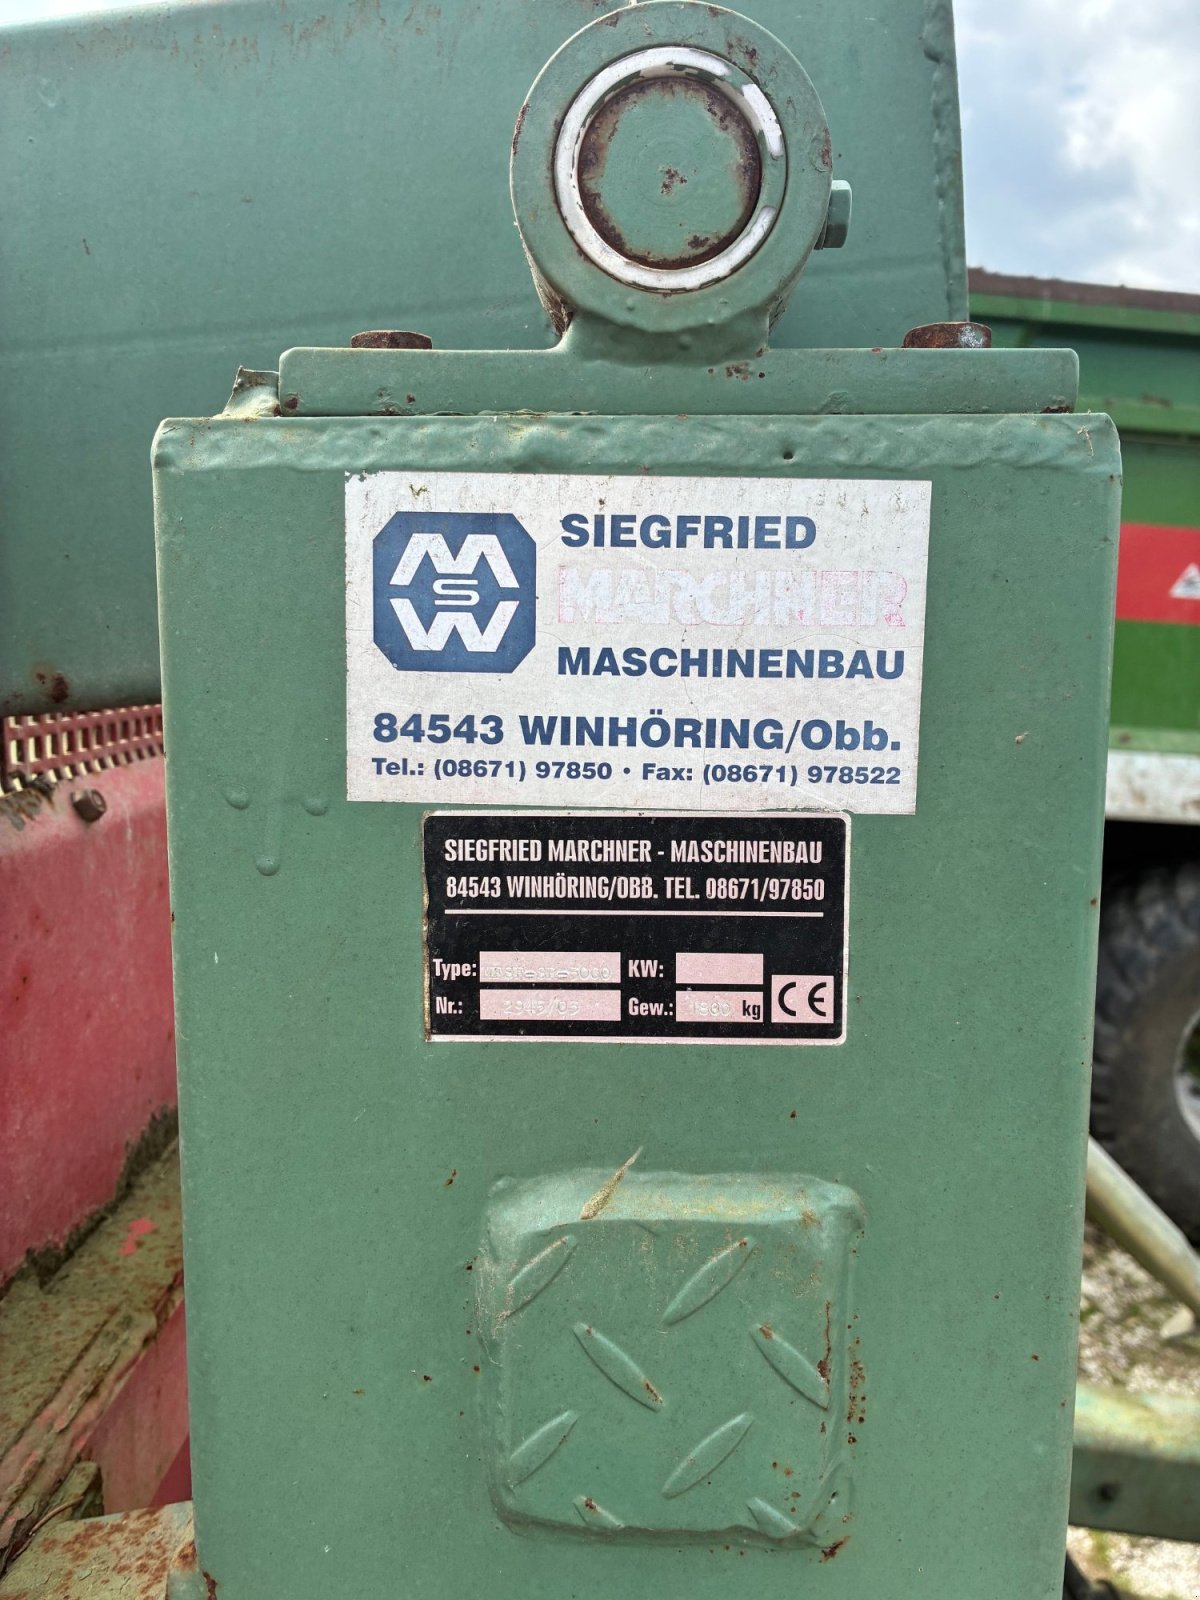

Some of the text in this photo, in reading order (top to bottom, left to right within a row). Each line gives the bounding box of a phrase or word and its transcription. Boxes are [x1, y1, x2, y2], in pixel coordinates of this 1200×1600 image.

[561, 513, 818, 549] SIEGFRIED
[557, 565, 907, 626] MARCHNER
[557, 646, 905, 680] MASCHINENBAU
[372, 709, 902, 754] 84543 WINHÖRING/Obb.
[371, 757, 901, 786] Tel.: (08671) 97850 Fax: (08671) 978522
[444, 838, 542, 862] SIEGFRIED
[548, 839, 652, 863] MARCHNER
[670, 840, 823, 864] MASCHINENBAU
[446, 872, 825, 901] 84543 WINHÖRING/OBB. TEL. 08671/97850
[433, 959, 477, 978] Type:
[628, 960, 664, 978] KW:
[436, 998, 463, 1015] Nr.:
[628, 998, 673, 1016] Gew.:
[742, 999, 761, 1020] kg
